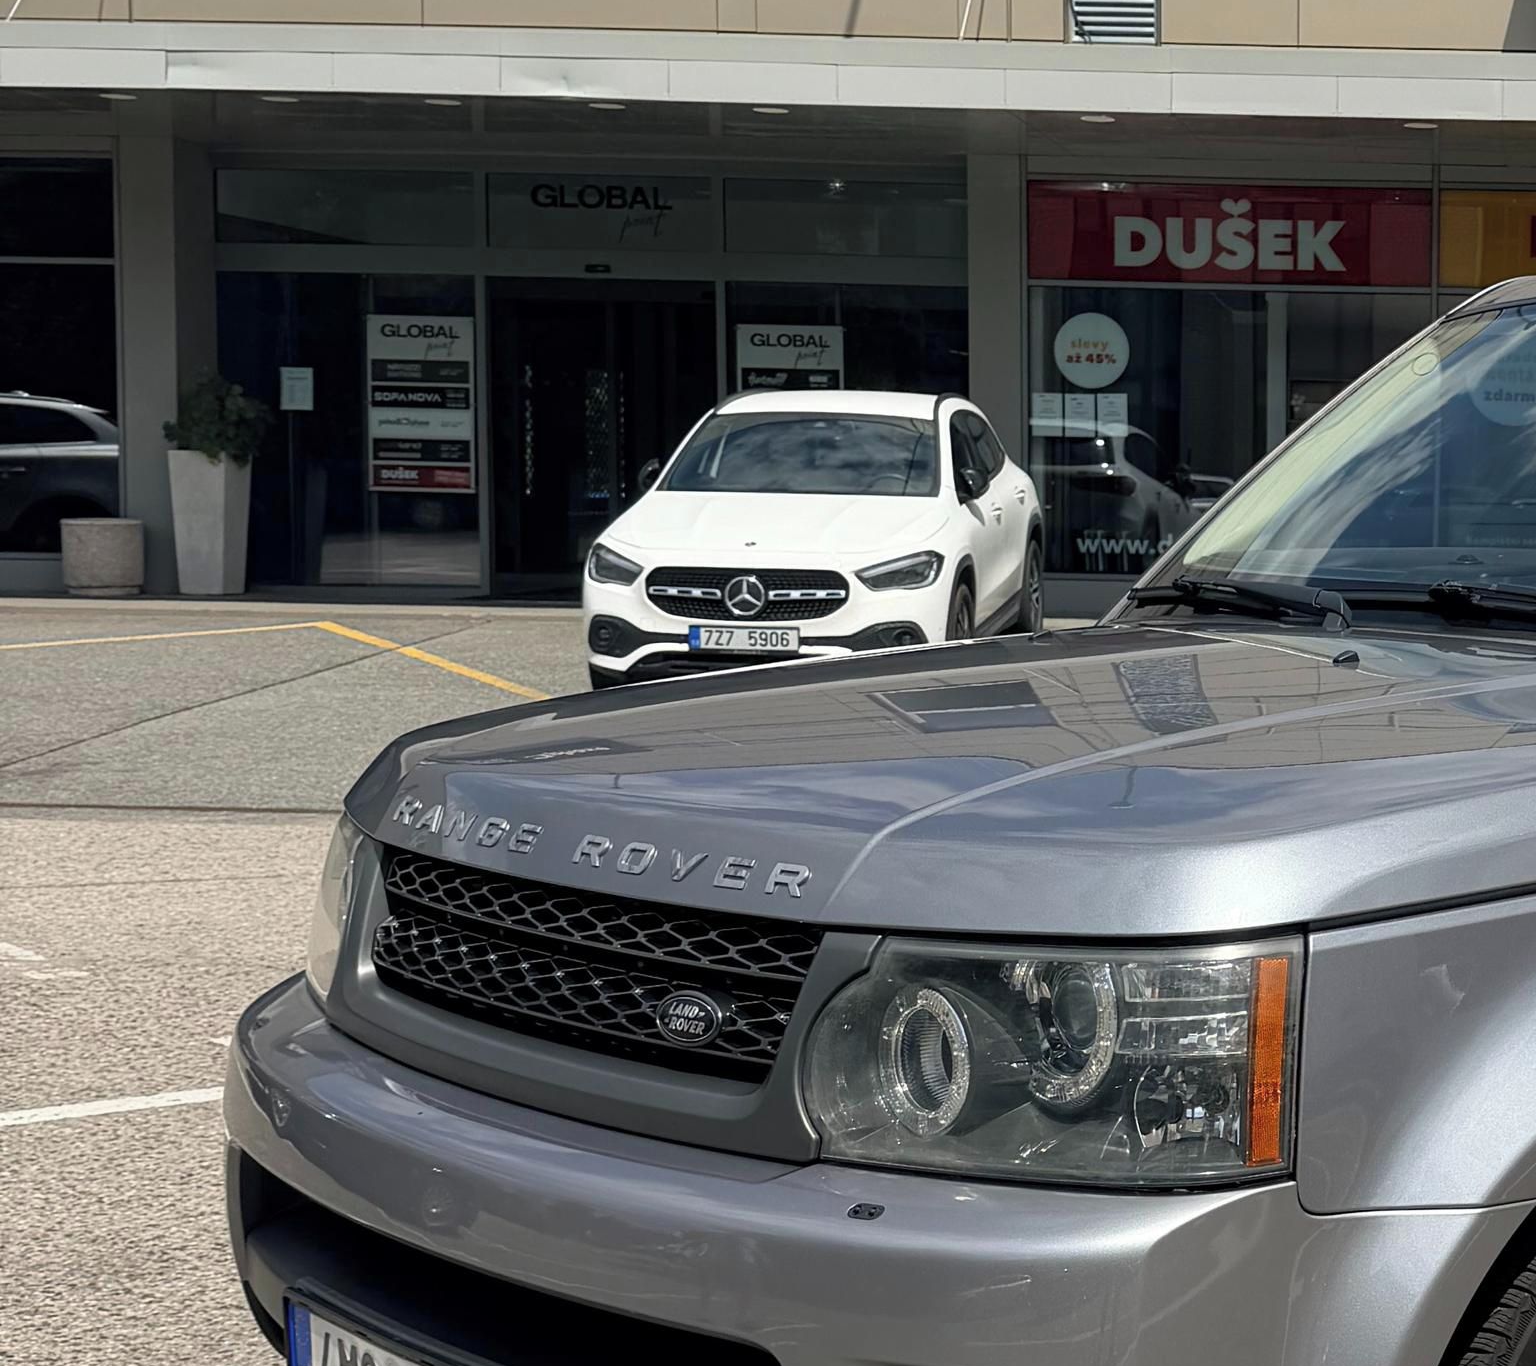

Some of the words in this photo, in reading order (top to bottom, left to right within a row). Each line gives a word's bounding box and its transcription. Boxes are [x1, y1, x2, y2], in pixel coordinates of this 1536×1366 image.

[530, 183, 673, 210] GLOBAL
[1113, 199, 1346, 272] DUŠEK
[381, 323, 461, 339] GLOBAL
[750, 332, 831, 349] GLOBAL
[704, 629, 735, 646] 7Z7
[748, 631, 790, 648] 5906
[392, 795, 545, 854] RANGE
[572, 833, 812, 899] ROVER
[669, 1001, 699, 1018] LAND
[668, 1016, 705, 1035] ROVER
